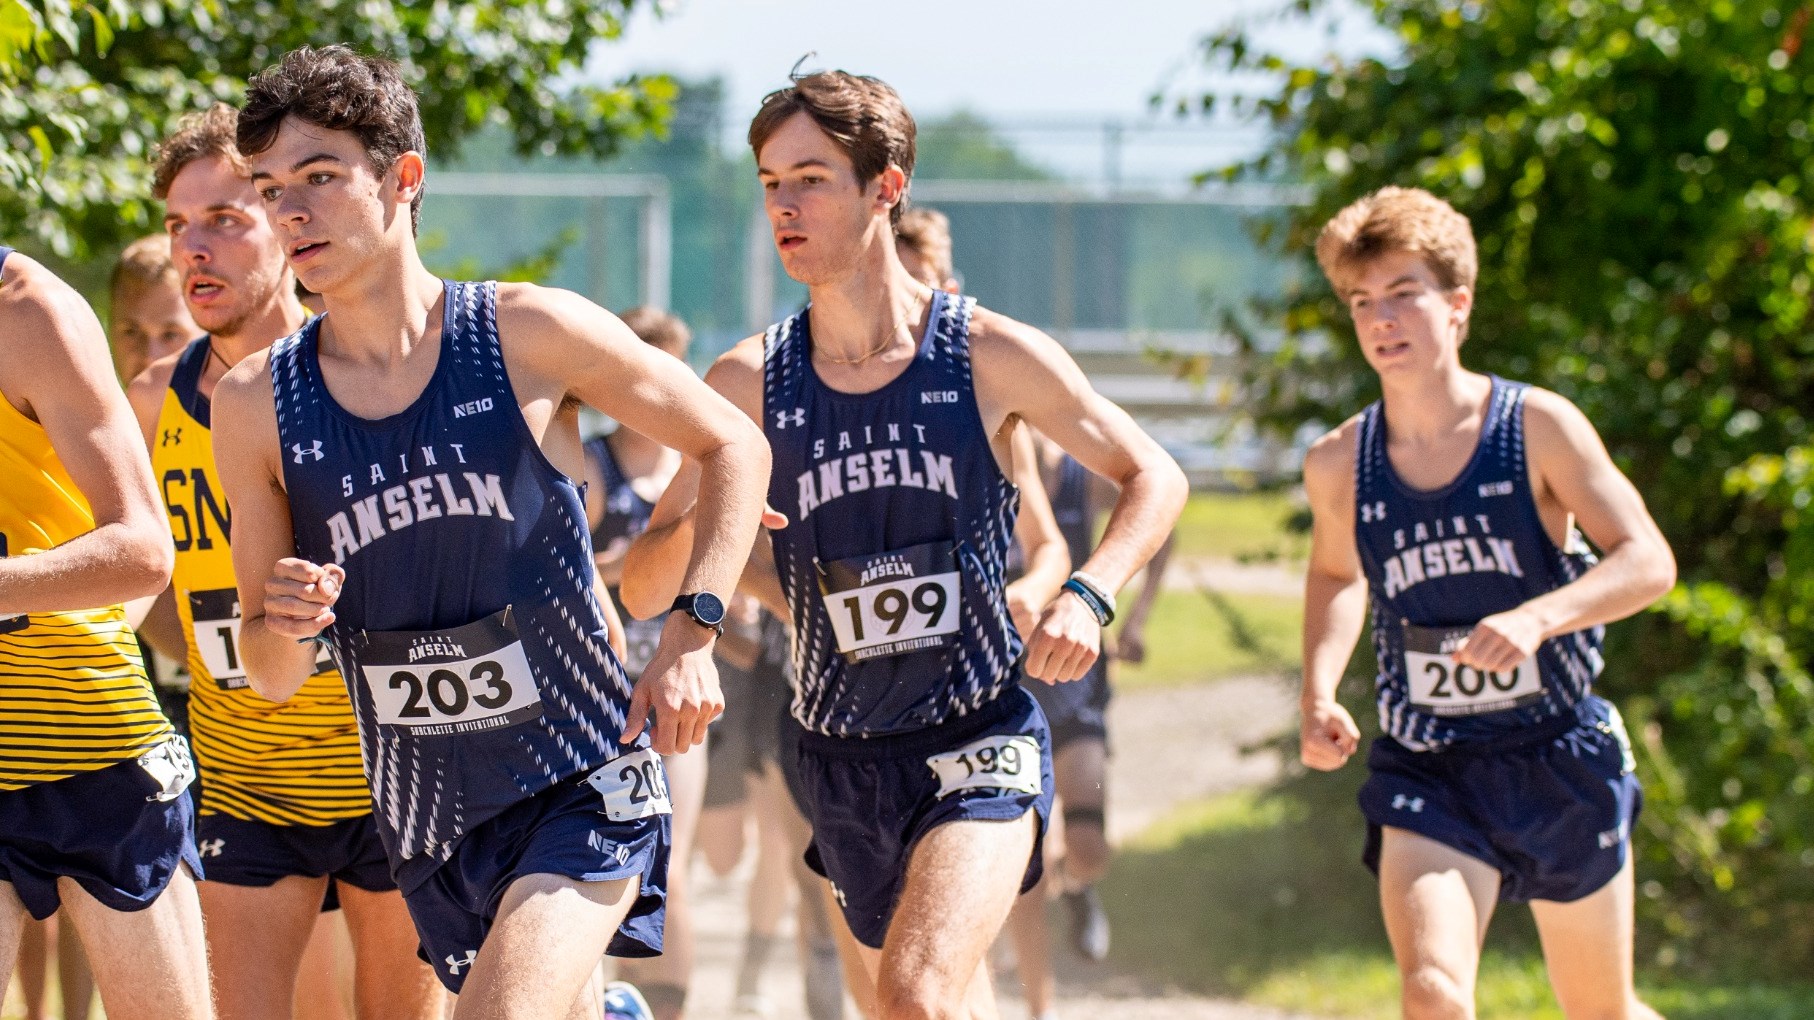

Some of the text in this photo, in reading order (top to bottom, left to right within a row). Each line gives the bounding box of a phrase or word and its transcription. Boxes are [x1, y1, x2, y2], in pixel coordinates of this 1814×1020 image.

[453, 397, 494, 418] NE10
[921, 390, 959, 404] NE10
[813, 423, 926, 459] SAINT
[342, 443, 467, 498] SAINT
[796, 448, 959, 521] ANSELM
[326, 472, 515, 566] ANSELM
[1393, 514, 1491, 550] SAINT
[860, 561, 916, 587] ANSELM
[867, 554, 904, 569] SAINT
[1383, 536, 1525, 599] ANSELM
[843, 581, 947, 642] 199
[408, 643, 467, 664] ANSELM
[412, 636, 453, 646] SAINT
[388, 660, 513, 718] 203
[1424, 661, 1519, 697] 200
[455, 715, 510, 733] INVITATIONAL
[955, 745, 1022, 779] 199
[587, 829, 631, 867] NE10
